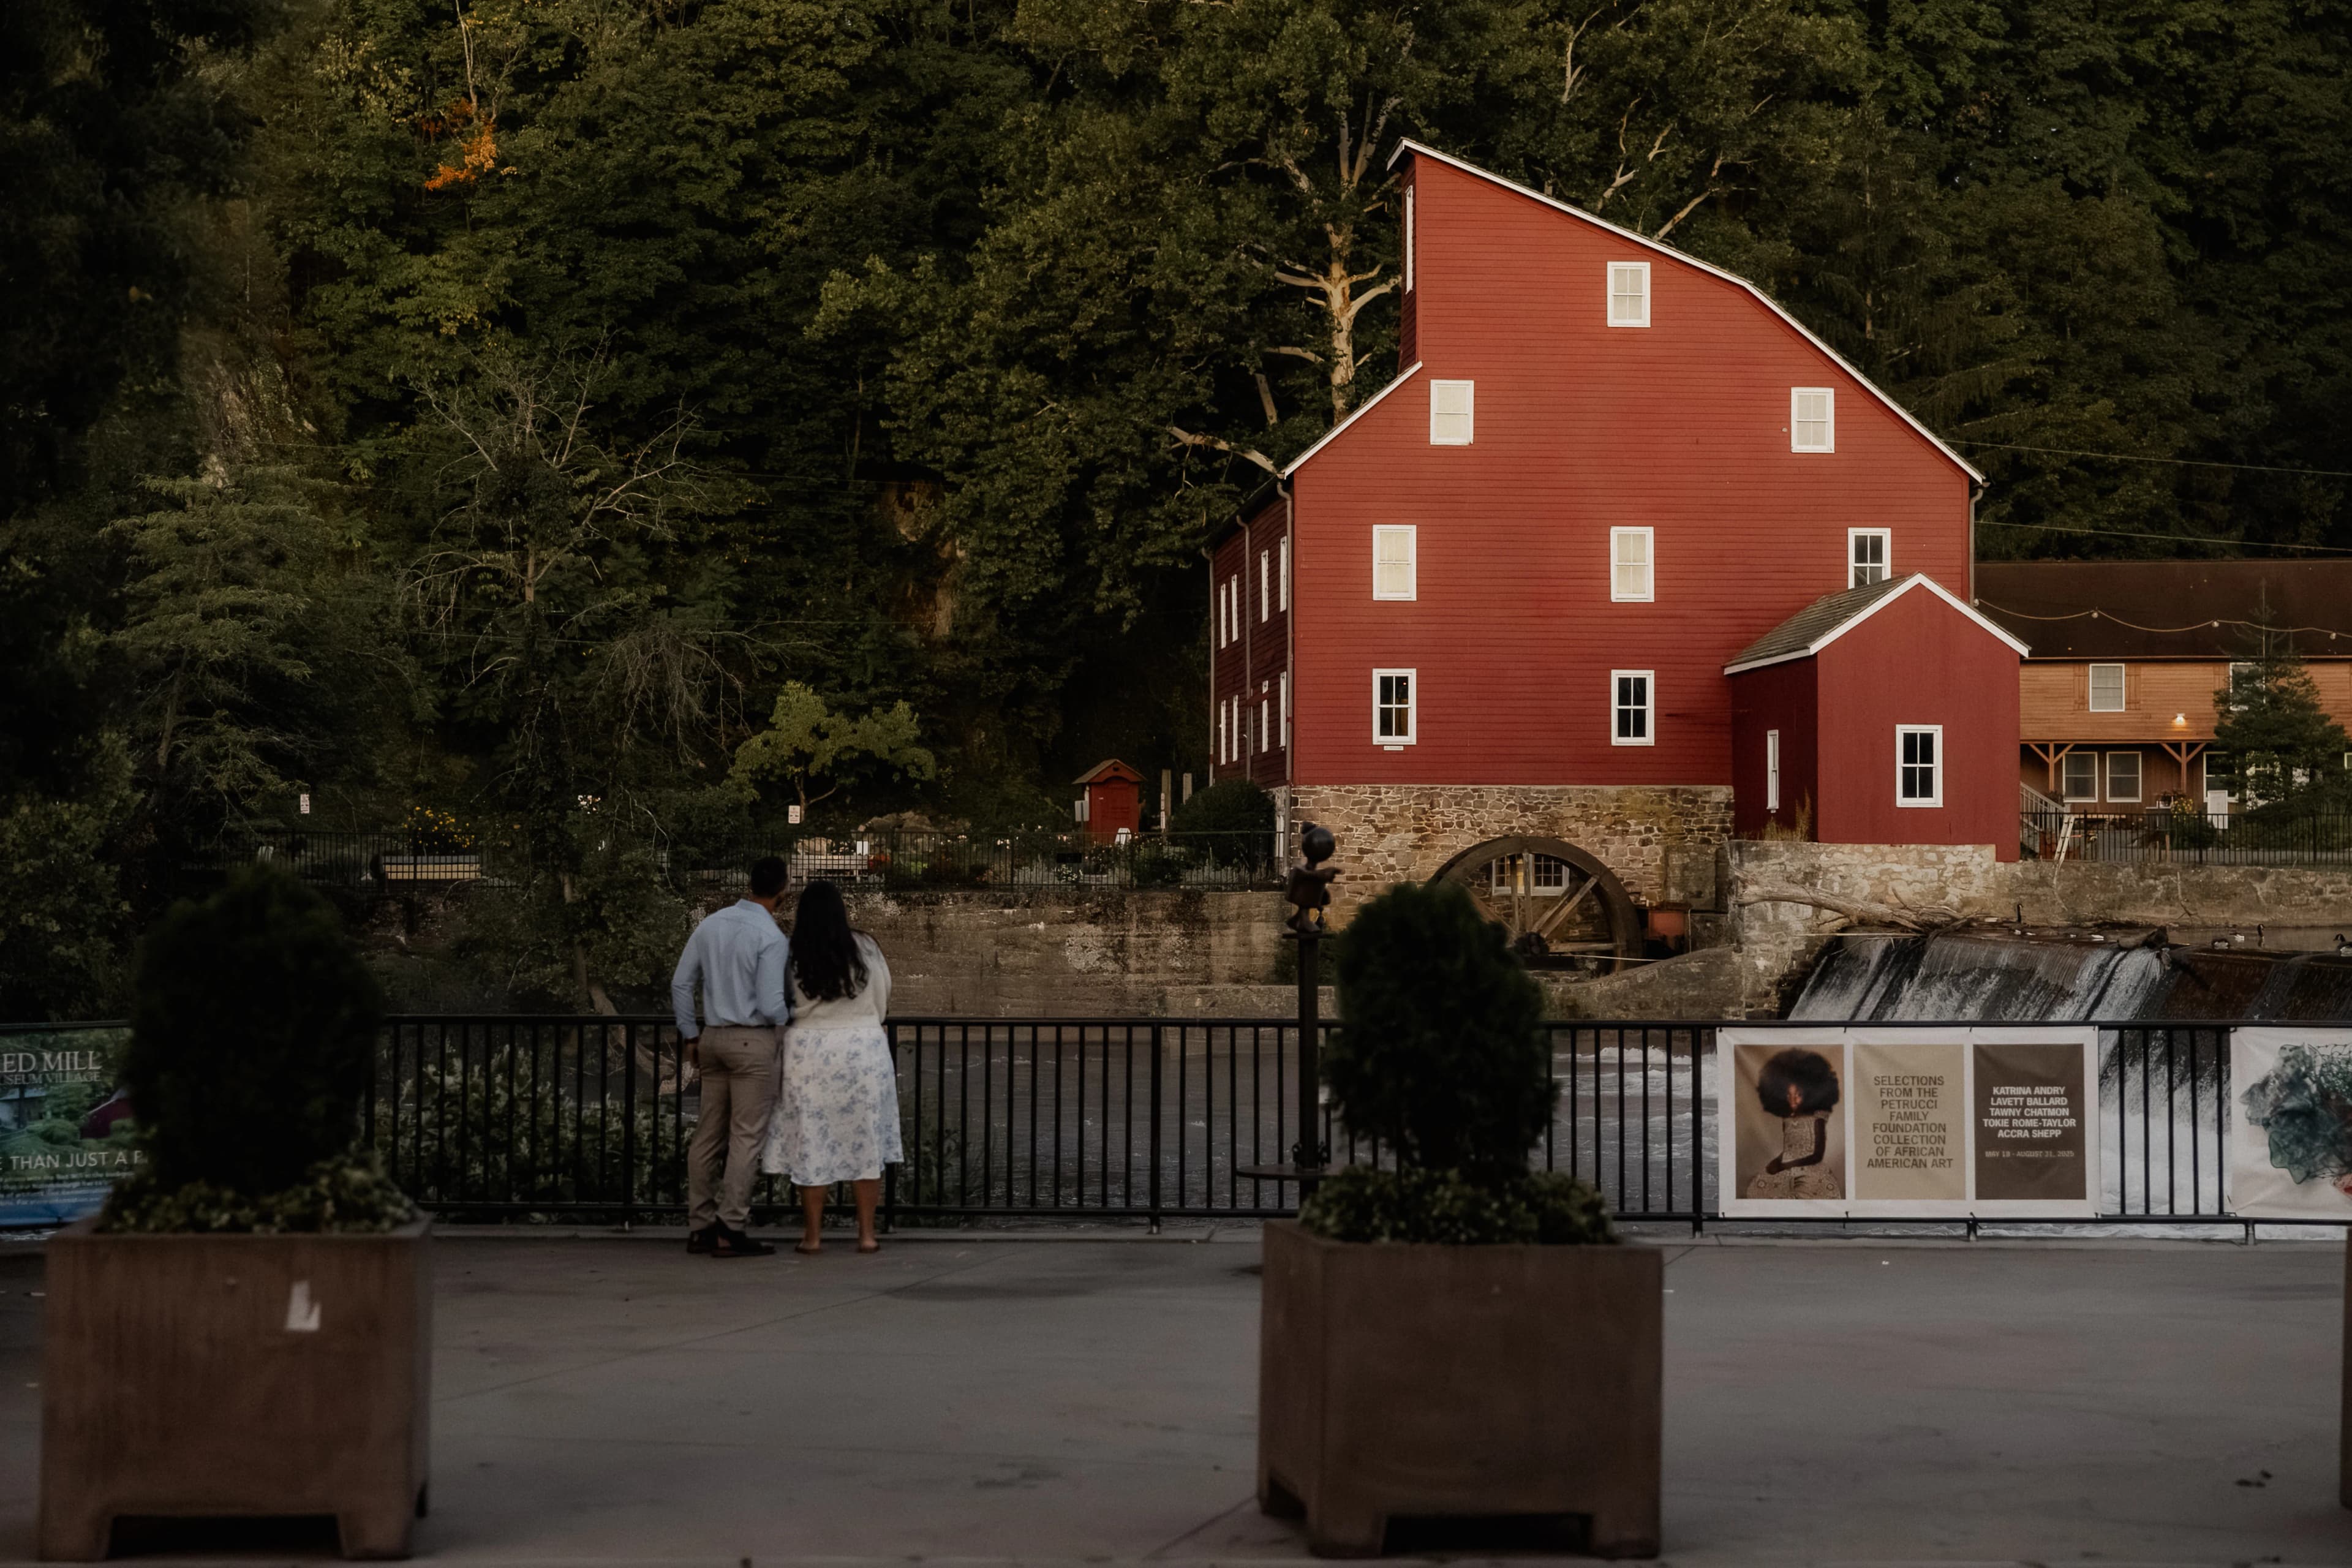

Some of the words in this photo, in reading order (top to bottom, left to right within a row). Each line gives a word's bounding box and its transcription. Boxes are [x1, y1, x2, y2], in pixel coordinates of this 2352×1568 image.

[0, 1052, 36, 1072] ED
[40, 1050, 103, 1071] MILL
[45, 1071, 102, 1084] VILLAGE
[1874, 1076, 1945, 1086] SELECTIONS
[1880, 1087, 1913, 1098] FROM
[1916, 1087, 1939, 1098] THE
[1992, 1087, 2032, 1095] KATRINA
[2034, 1086, 2066, 1095] ANDRY
[1881, 1099, 1938, 1109] PETRUCCI
[1991, 1097, 2024, 1106] LAVETT
[2026, 1097, 2068, 1106] BALLARD
[1890, 1111, 1929, 1121] FAMILY
[1989, 1107, 2022, 1117] TAWNY
[2024, 1107, 2070, 1117] CHATMON
[1983, 1118, 2010, 1127] TOKIE
[2012, 1118, 2076, 1127] ROME-TAYLOR
[1872, 1123, 1947, 1133] FOUNDATION
[1997, 1129, 2030, 1138] ACCRA
[2032, 1129, 2062, 1138] SHEPP
[1873, 1134, 1946, 1145] COLLECTION
[1875, 1146, 1892, 1156] OF
[1894, 1146, 1945, 1156] AFRICAN
[10, 1154, 60, 1170] THAN
[66, 1151, 110, 1168] JUST
[115, 1151, 128, 1165] A
[1867, 1158, 1928, 1169] AMERICAN
[1931, 1158, 1954, 1169] ART
